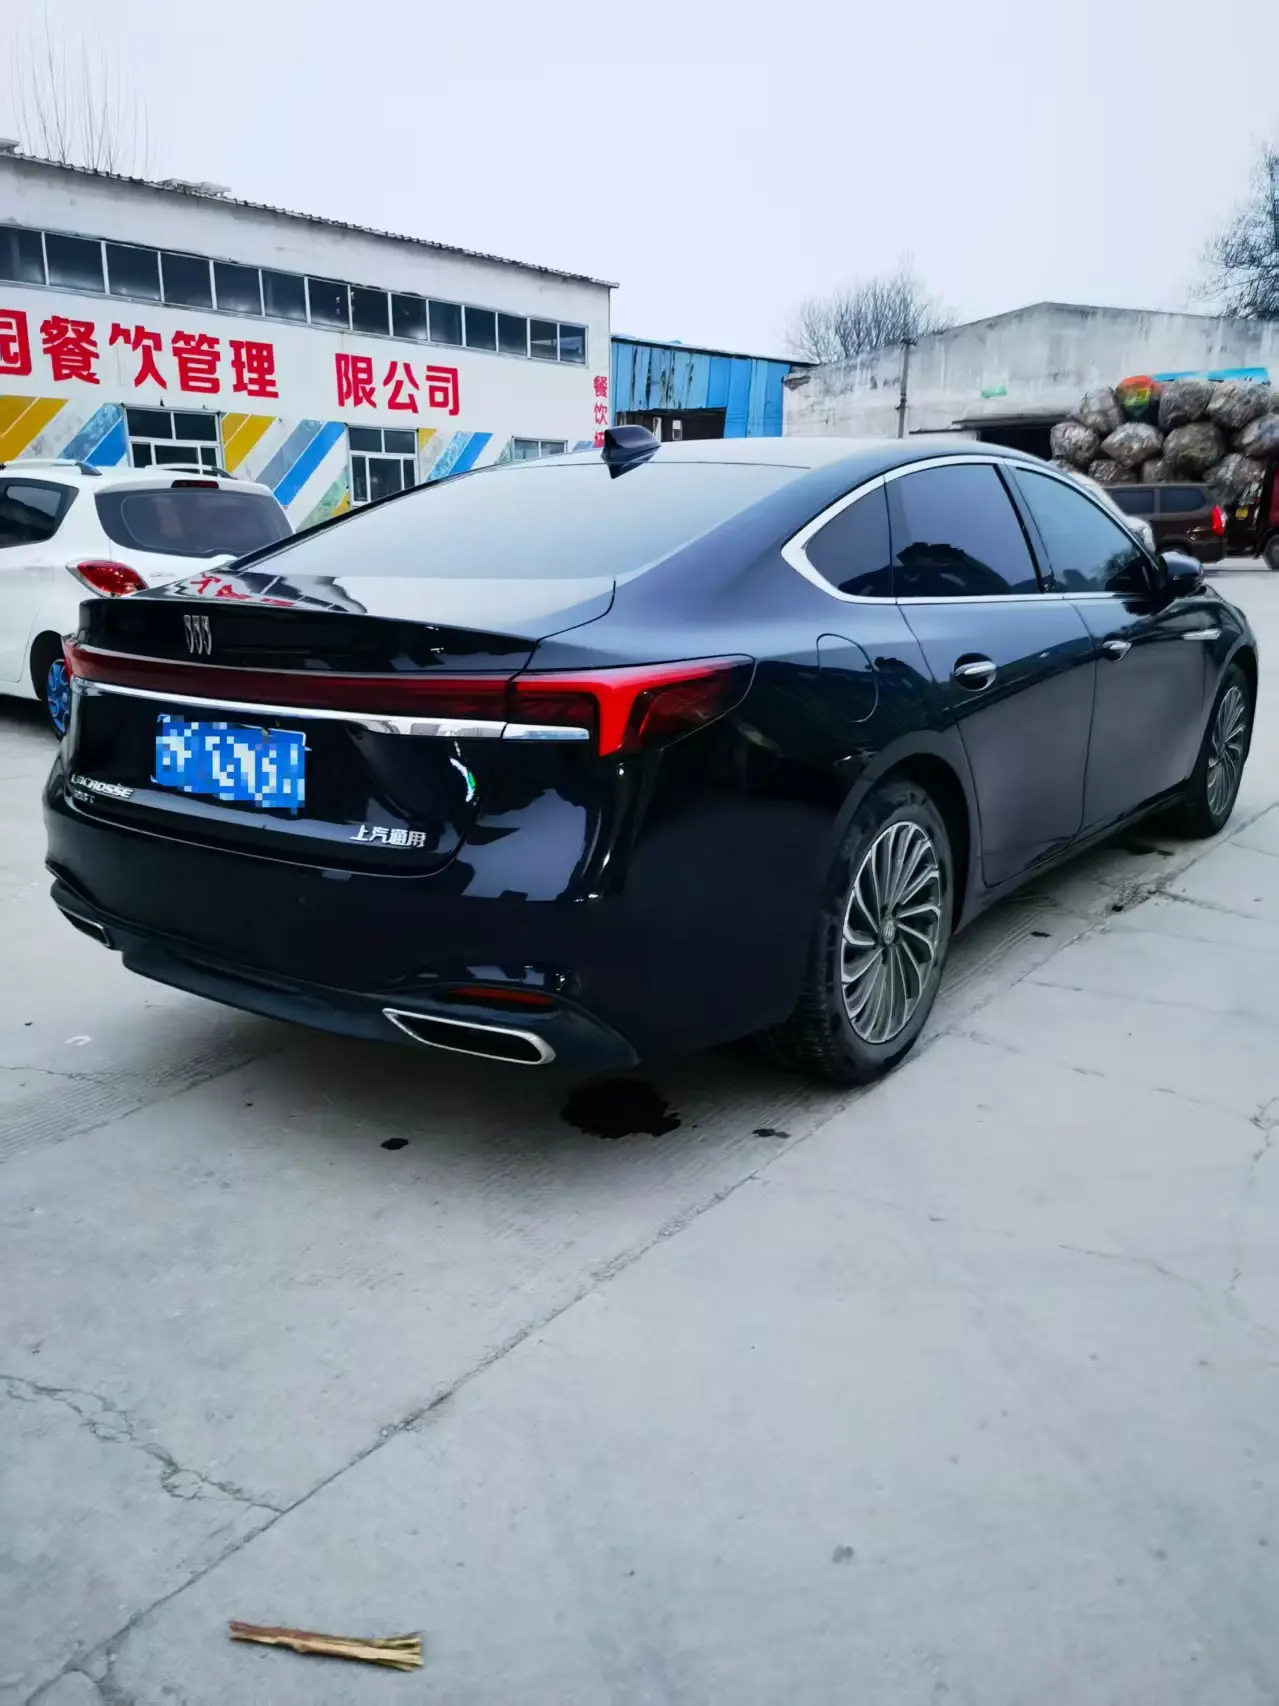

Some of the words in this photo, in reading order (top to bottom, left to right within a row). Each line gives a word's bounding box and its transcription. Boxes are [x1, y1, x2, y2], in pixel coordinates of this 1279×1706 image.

[335, 352, 461, 416] 限公司
[350, 824, 426, 847] 上汽通用
